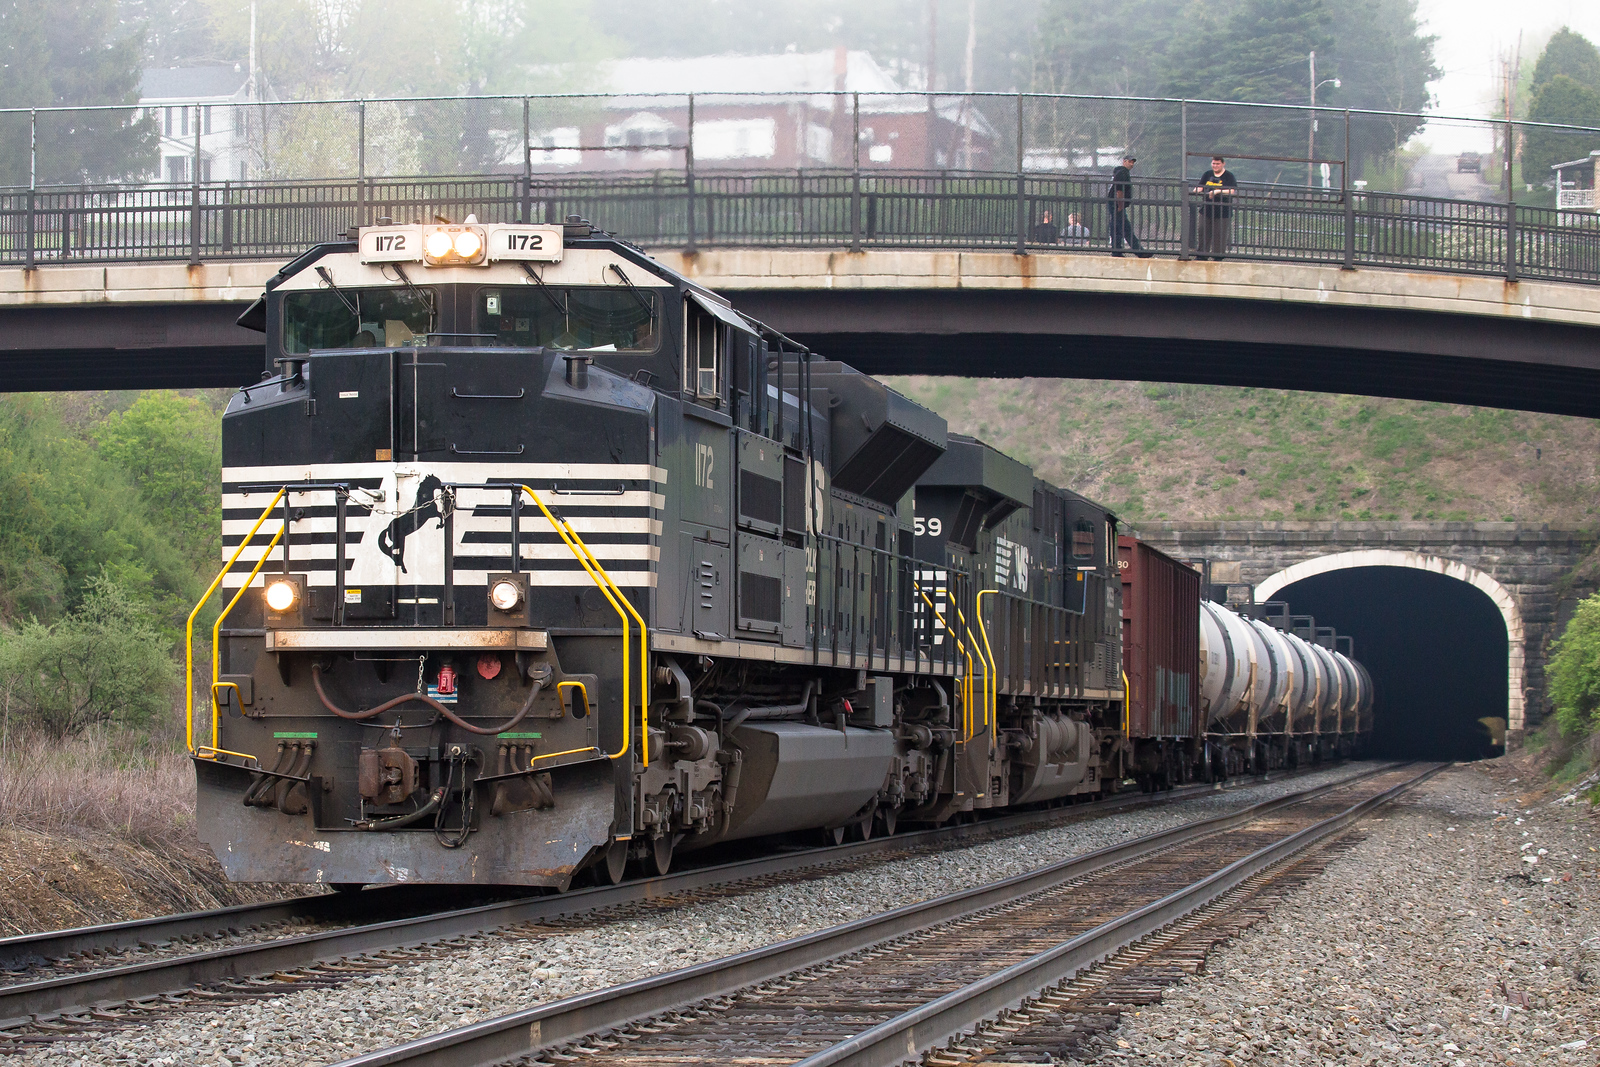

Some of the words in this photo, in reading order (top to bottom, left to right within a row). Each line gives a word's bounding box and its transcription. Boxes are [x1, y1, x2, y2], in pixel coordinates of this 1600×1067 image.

[375, 235, 406, 251] 1172
[508, 234, 543, 250] 1172
[695, 442, 714, 490] 1172
